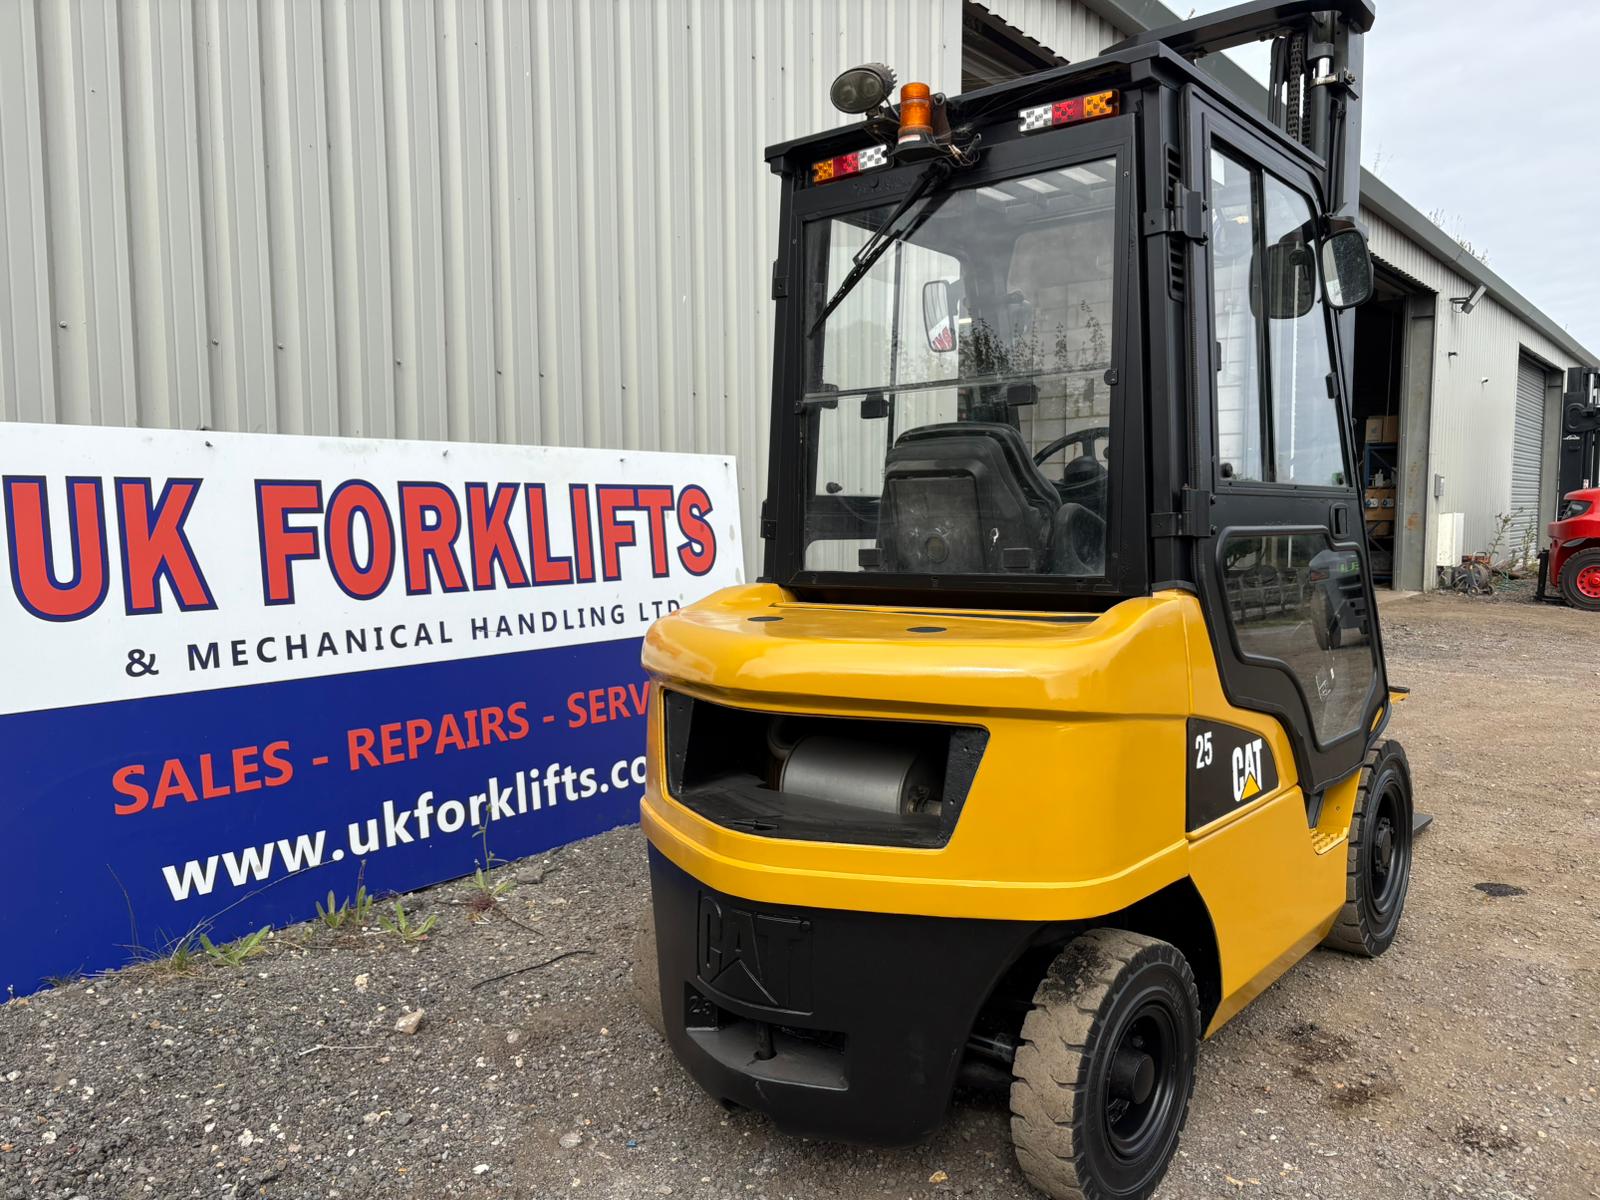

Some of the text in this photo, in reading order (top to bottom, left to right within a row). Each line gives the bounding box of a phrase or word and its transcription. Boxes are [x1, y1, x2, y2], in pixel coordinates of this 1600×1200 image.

[2, 475, 717, 623] UK FORKLIFTS
[125, 648, 159, 678] &
[187, 621, 454, 671] MECHANICAL
[470, 604, 626, 641] HANDLING
[112, 741, 295, 815] SALES
[347, 702, 530, 771] REPAIRS
[1195, 731, 1213, 769] 25
[1231, 738, 1263, 802] CAT
